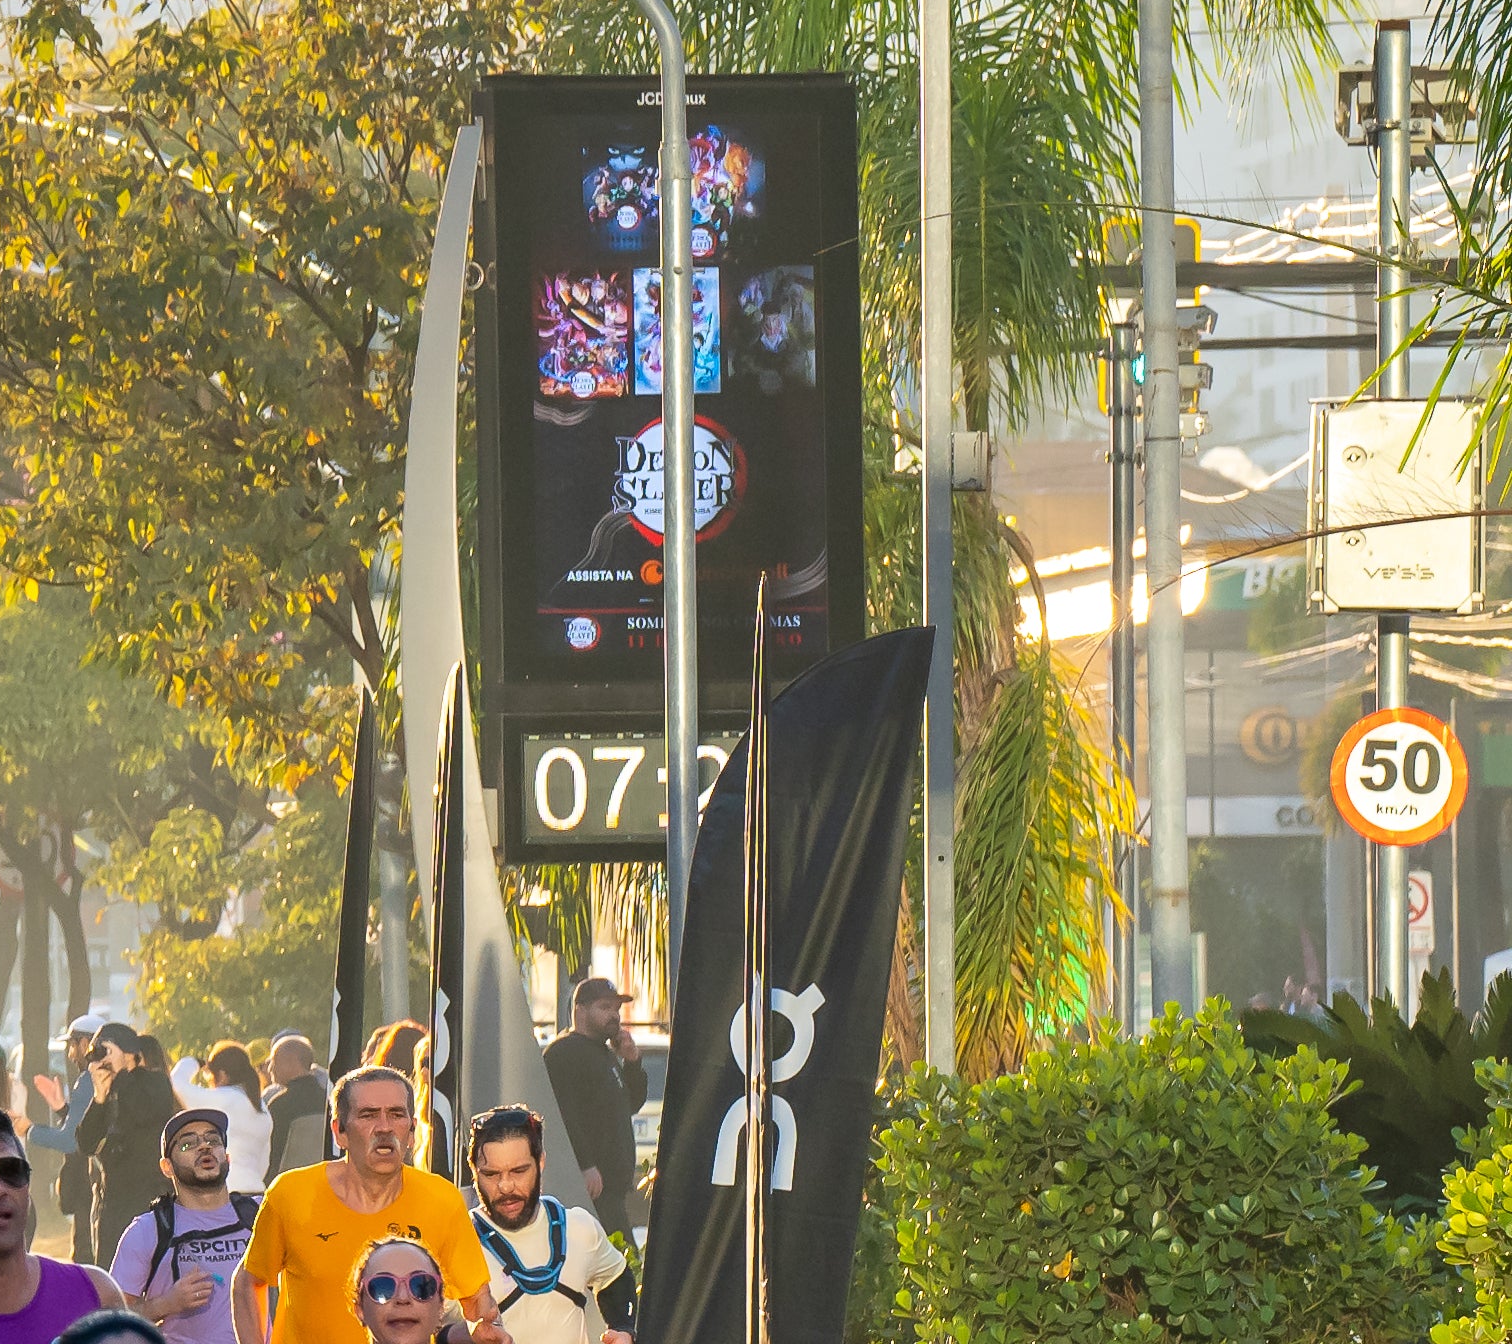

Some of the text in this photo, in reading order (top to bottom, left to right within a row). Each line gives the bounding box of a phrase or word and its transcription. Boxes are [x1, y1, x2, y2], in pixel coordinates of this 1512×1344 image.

[636, 91, 706, 107] JCDaux
[615, 436, 735, 476] DEON
[567, 569, 633, 582] ASSISTA NA
[1359, 739, 1442, 794] 50
[1375, 803, 1419, 817] km/h
